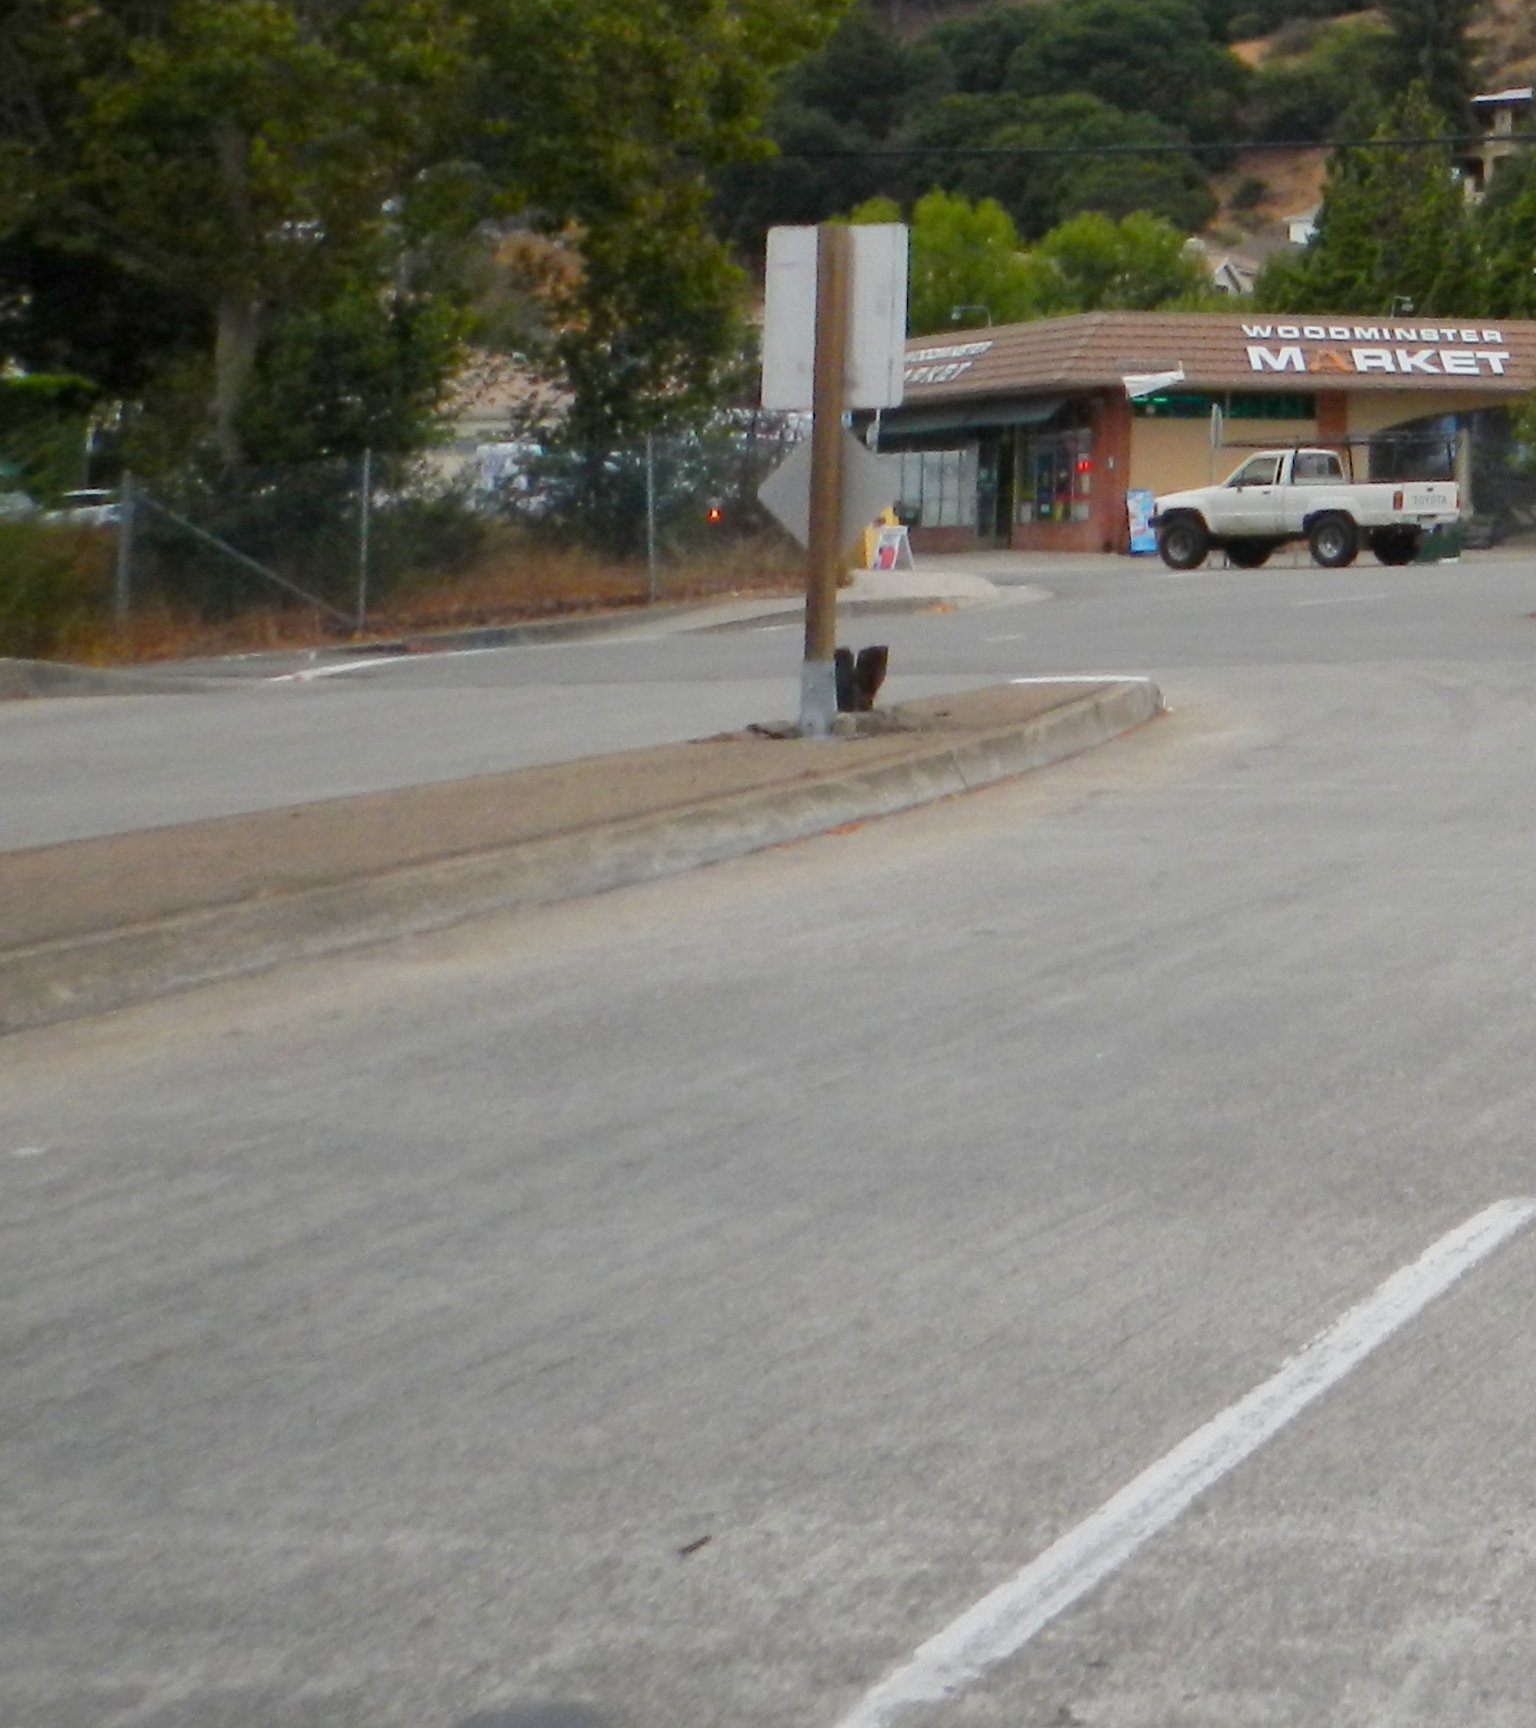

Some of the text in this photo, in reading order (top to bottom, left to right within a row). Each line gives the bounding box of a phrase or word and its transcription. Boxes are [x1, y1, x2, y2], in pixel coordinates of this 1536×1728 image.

[1242, 324, 1503, 343] WOODMINSTER
[1246, 345, 1510, 375] MARKET
[1412, 494, 1449, 505] TOYOTA
